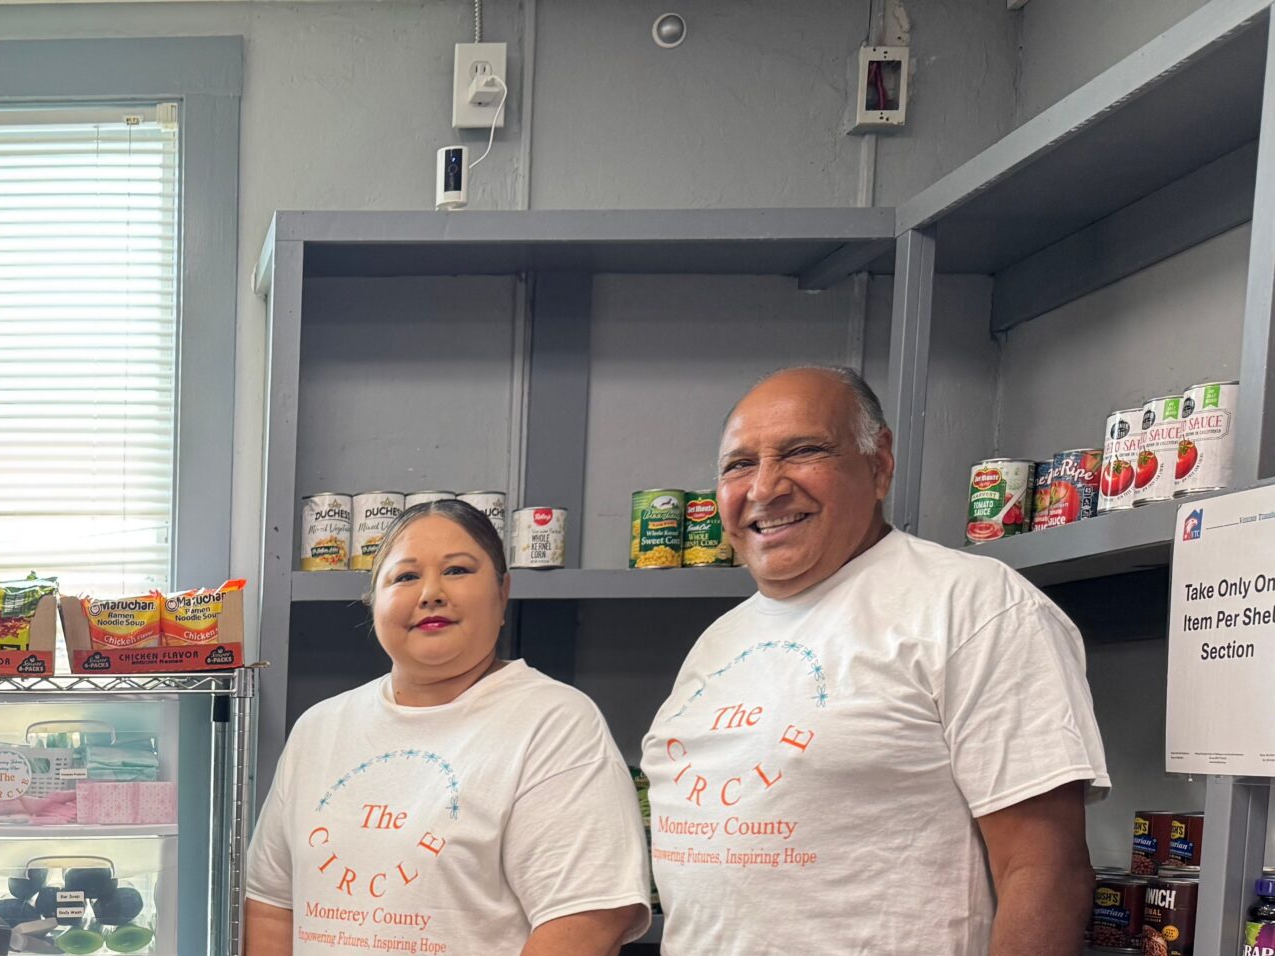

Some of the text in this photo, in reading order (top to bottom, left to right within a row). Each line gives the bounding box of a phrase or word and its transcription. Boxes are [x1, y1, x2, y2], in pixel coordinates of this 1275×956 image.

[1189, 415, 1223, 430] SAUCE
[1149, 428, 1181, 440] SAUCE
[1060, 459, 1094, 481] Ripe
[974, 508, 991, 516] SAUCE
[532, 534, 550, 542] WHOLE
[641, 537, 664, 545] Sweet
[531, 551, 546, 559] CORN
[1185, 582, 1214, 601] Take
[1218, 577, 1251, 599] Only
[101, 600, 155, 611] Maruchan
[125, 619, 145, 627] Soup
[1184, 614, 1212, 631] Item
[1216, 611, 1239, 628] Per
[104, 635, 137, 647] Chicken
[184, 629, 214, 641] Chicken
[119, 651, 199, 661] CHICKEN FLAVOR
[1201, 640, 1254, 660] Section
[709, 702, 763, 731] The
[666, 724, 814, 807] CIRCLE
[361, 804, 407, 830] The
[658, 815, 798, 840] Monterey County
[308, 826, 446, 897] CIRCLE
[687, 848, 817, 868] Futures, Inspiring Hope
[305, 901, 431, 930] Monterey County
[338, 931, 447, 955] Futures, Inspiring Hope
